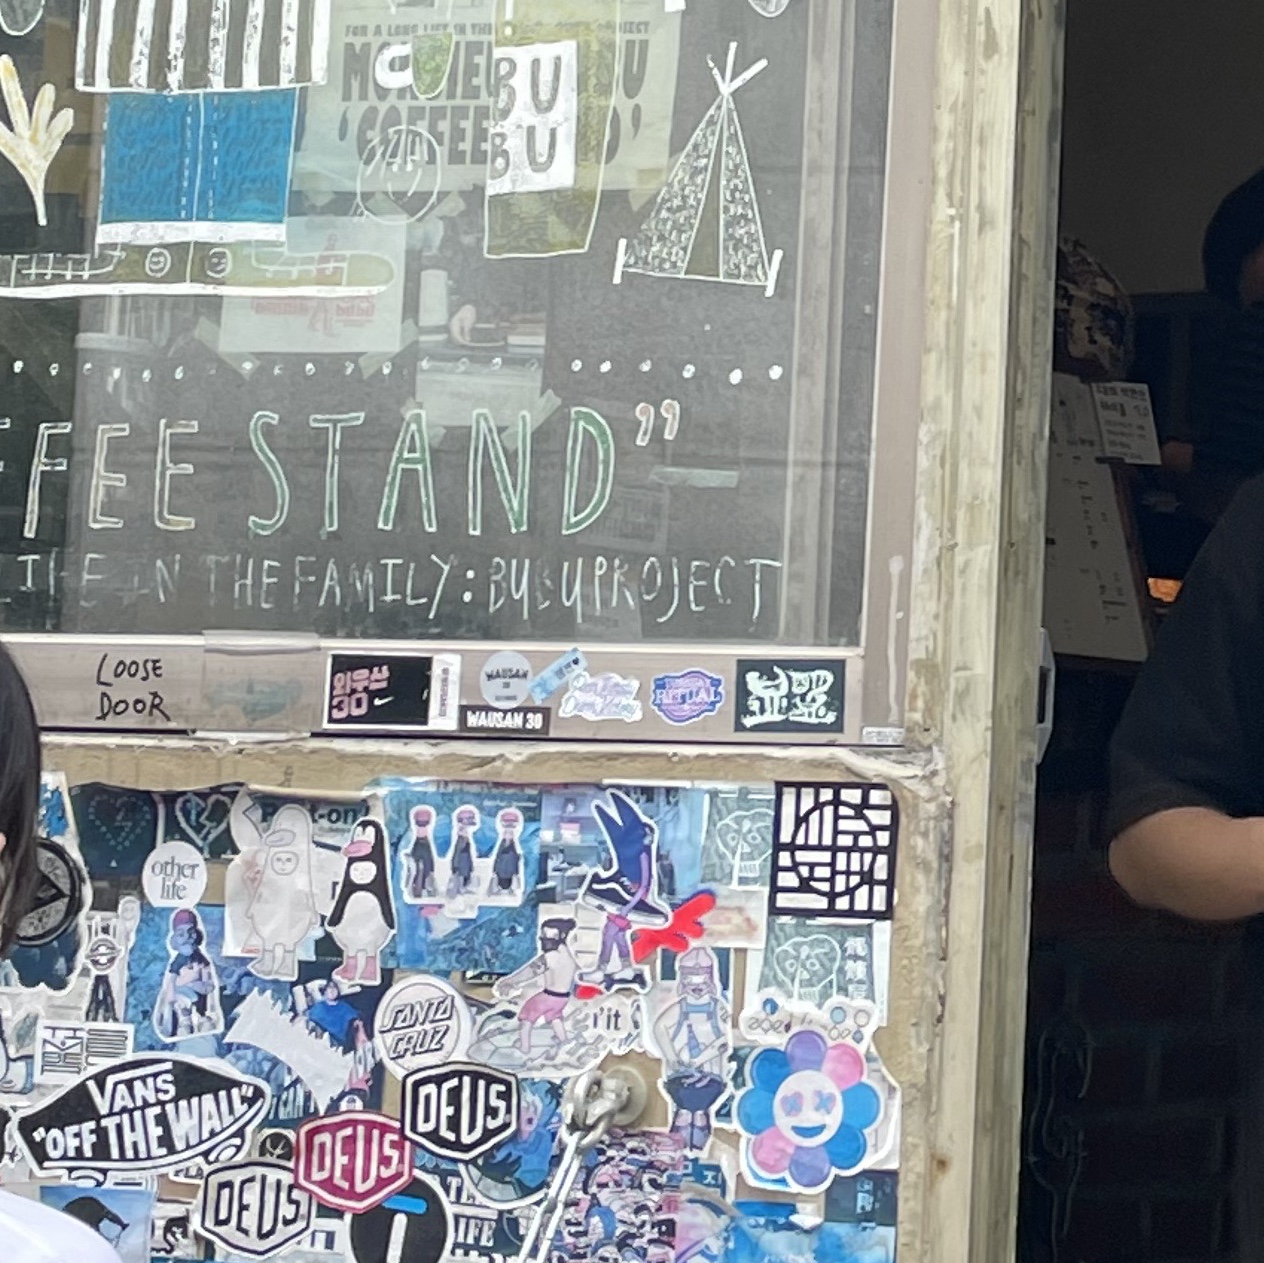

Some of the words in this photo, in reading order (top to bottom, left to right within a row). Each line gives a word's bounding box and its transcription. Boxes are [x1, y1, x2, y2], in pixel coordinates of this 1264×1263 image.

[0, 417, 198, 538] FEE
[207, 554, 281, 608] THE
[96, 653, 163, 687] LOOSE
[95, 691, 171, 721] DOOR
[332, 692, 368, 719] 30
[466, 710, 524, 728] WAUSAN
[526, 712, 543, 730] 30
[151, 856, 199, 881] other
[161, 877, 187, 900] life
[379, 995, 455, 1033] SANTA
[389, 1025, 450, 1060] CRUZ
[86, 1061, 176, 1115] VANS
[418, 1075, 507, 1145] DEUS
[101, 1108, 168, 1159] THE
[311, 1124, 400, 1194] DEUS
[214, 1171, 302, 1241] DEUS
